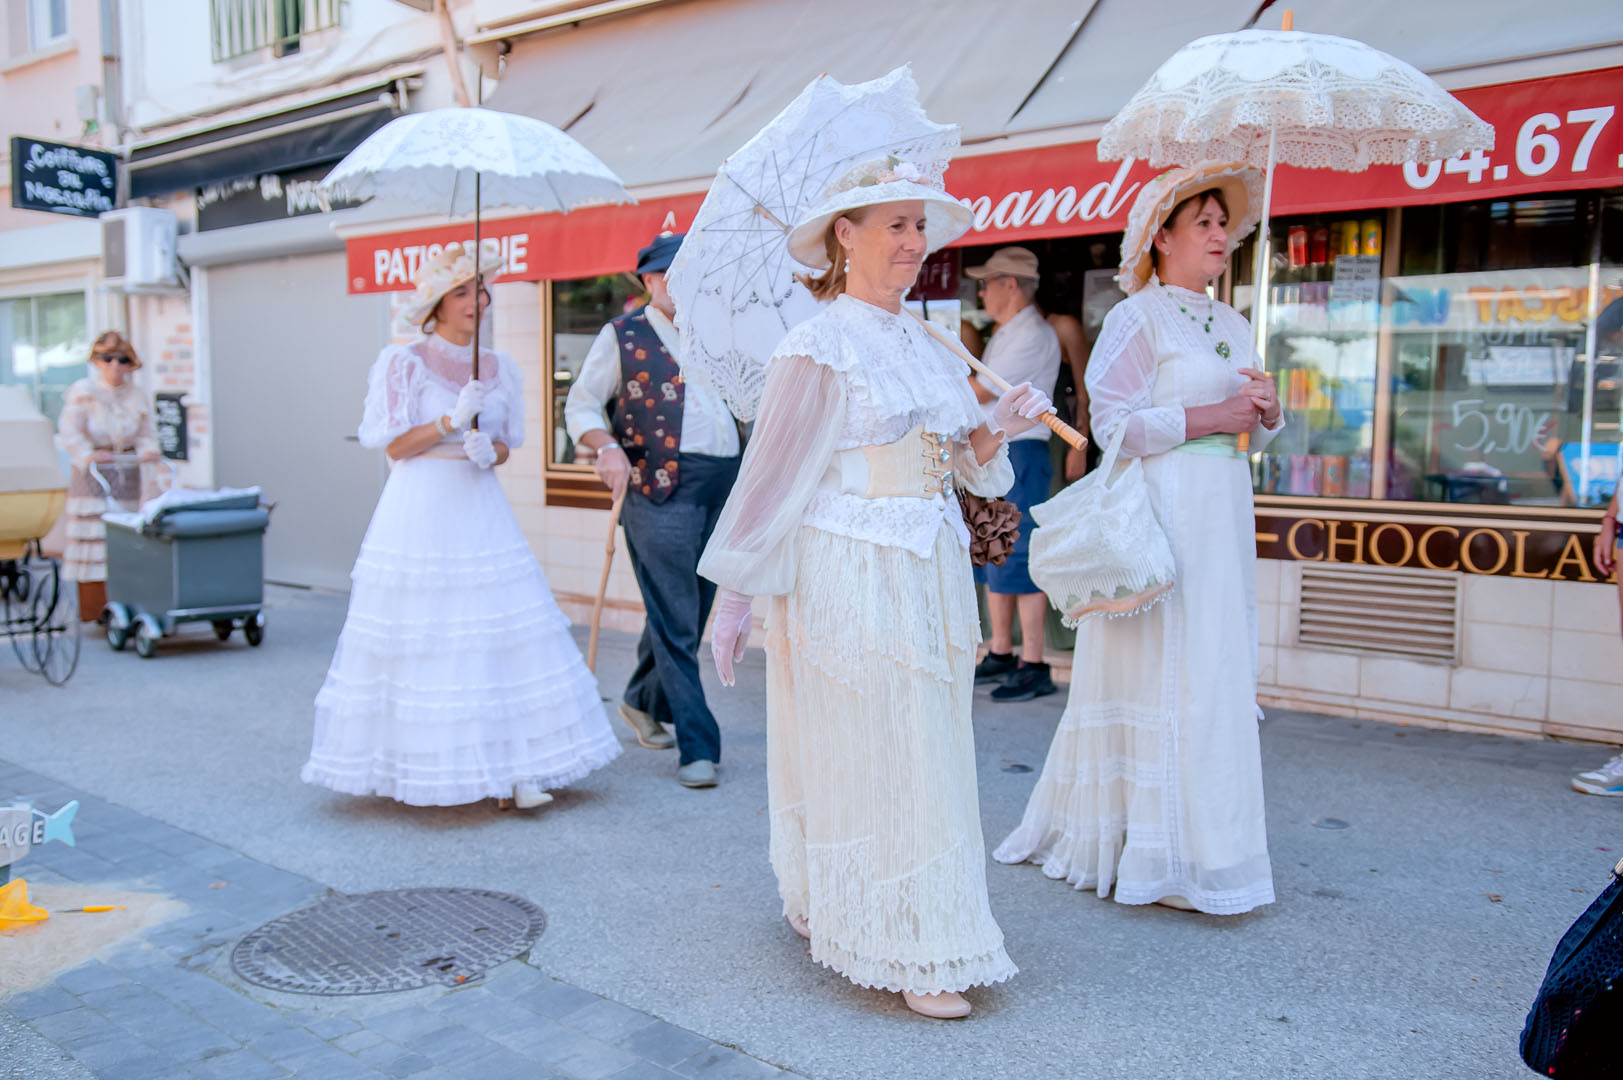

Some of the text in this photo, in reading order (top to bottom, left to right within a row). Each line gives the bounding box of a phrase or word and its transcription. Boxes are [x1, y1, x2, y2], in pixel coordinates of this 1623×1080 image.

[374, 233, 529, 286] PATIIE
[1452, 399, 1551, 455] 5,90€
[1287, 518, 1616, 584] CHOCOLA
